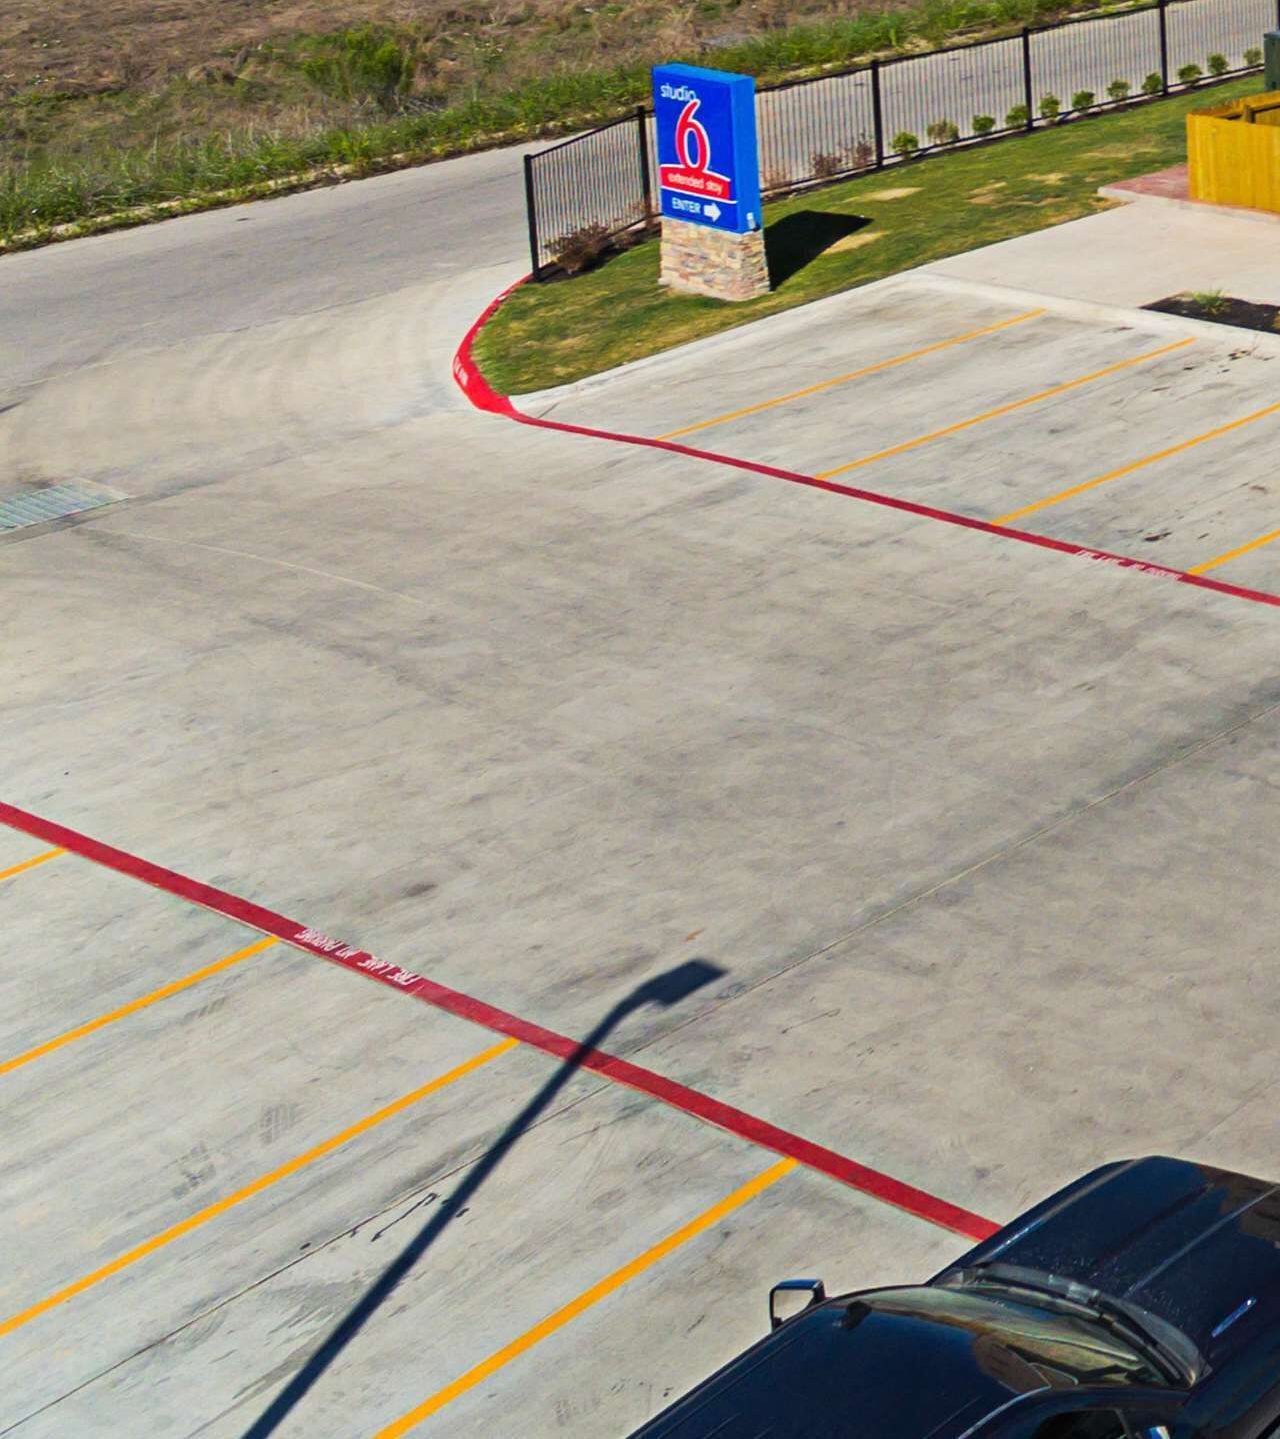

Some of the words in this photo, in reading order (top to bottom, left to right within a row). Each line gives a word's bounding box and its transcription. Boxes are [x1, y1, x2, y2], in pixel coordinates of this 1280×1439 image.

[660, 82, 697, 103] studio
[675, 98, 711, 172] 6
[672, 196, 701, 214] ENTER
